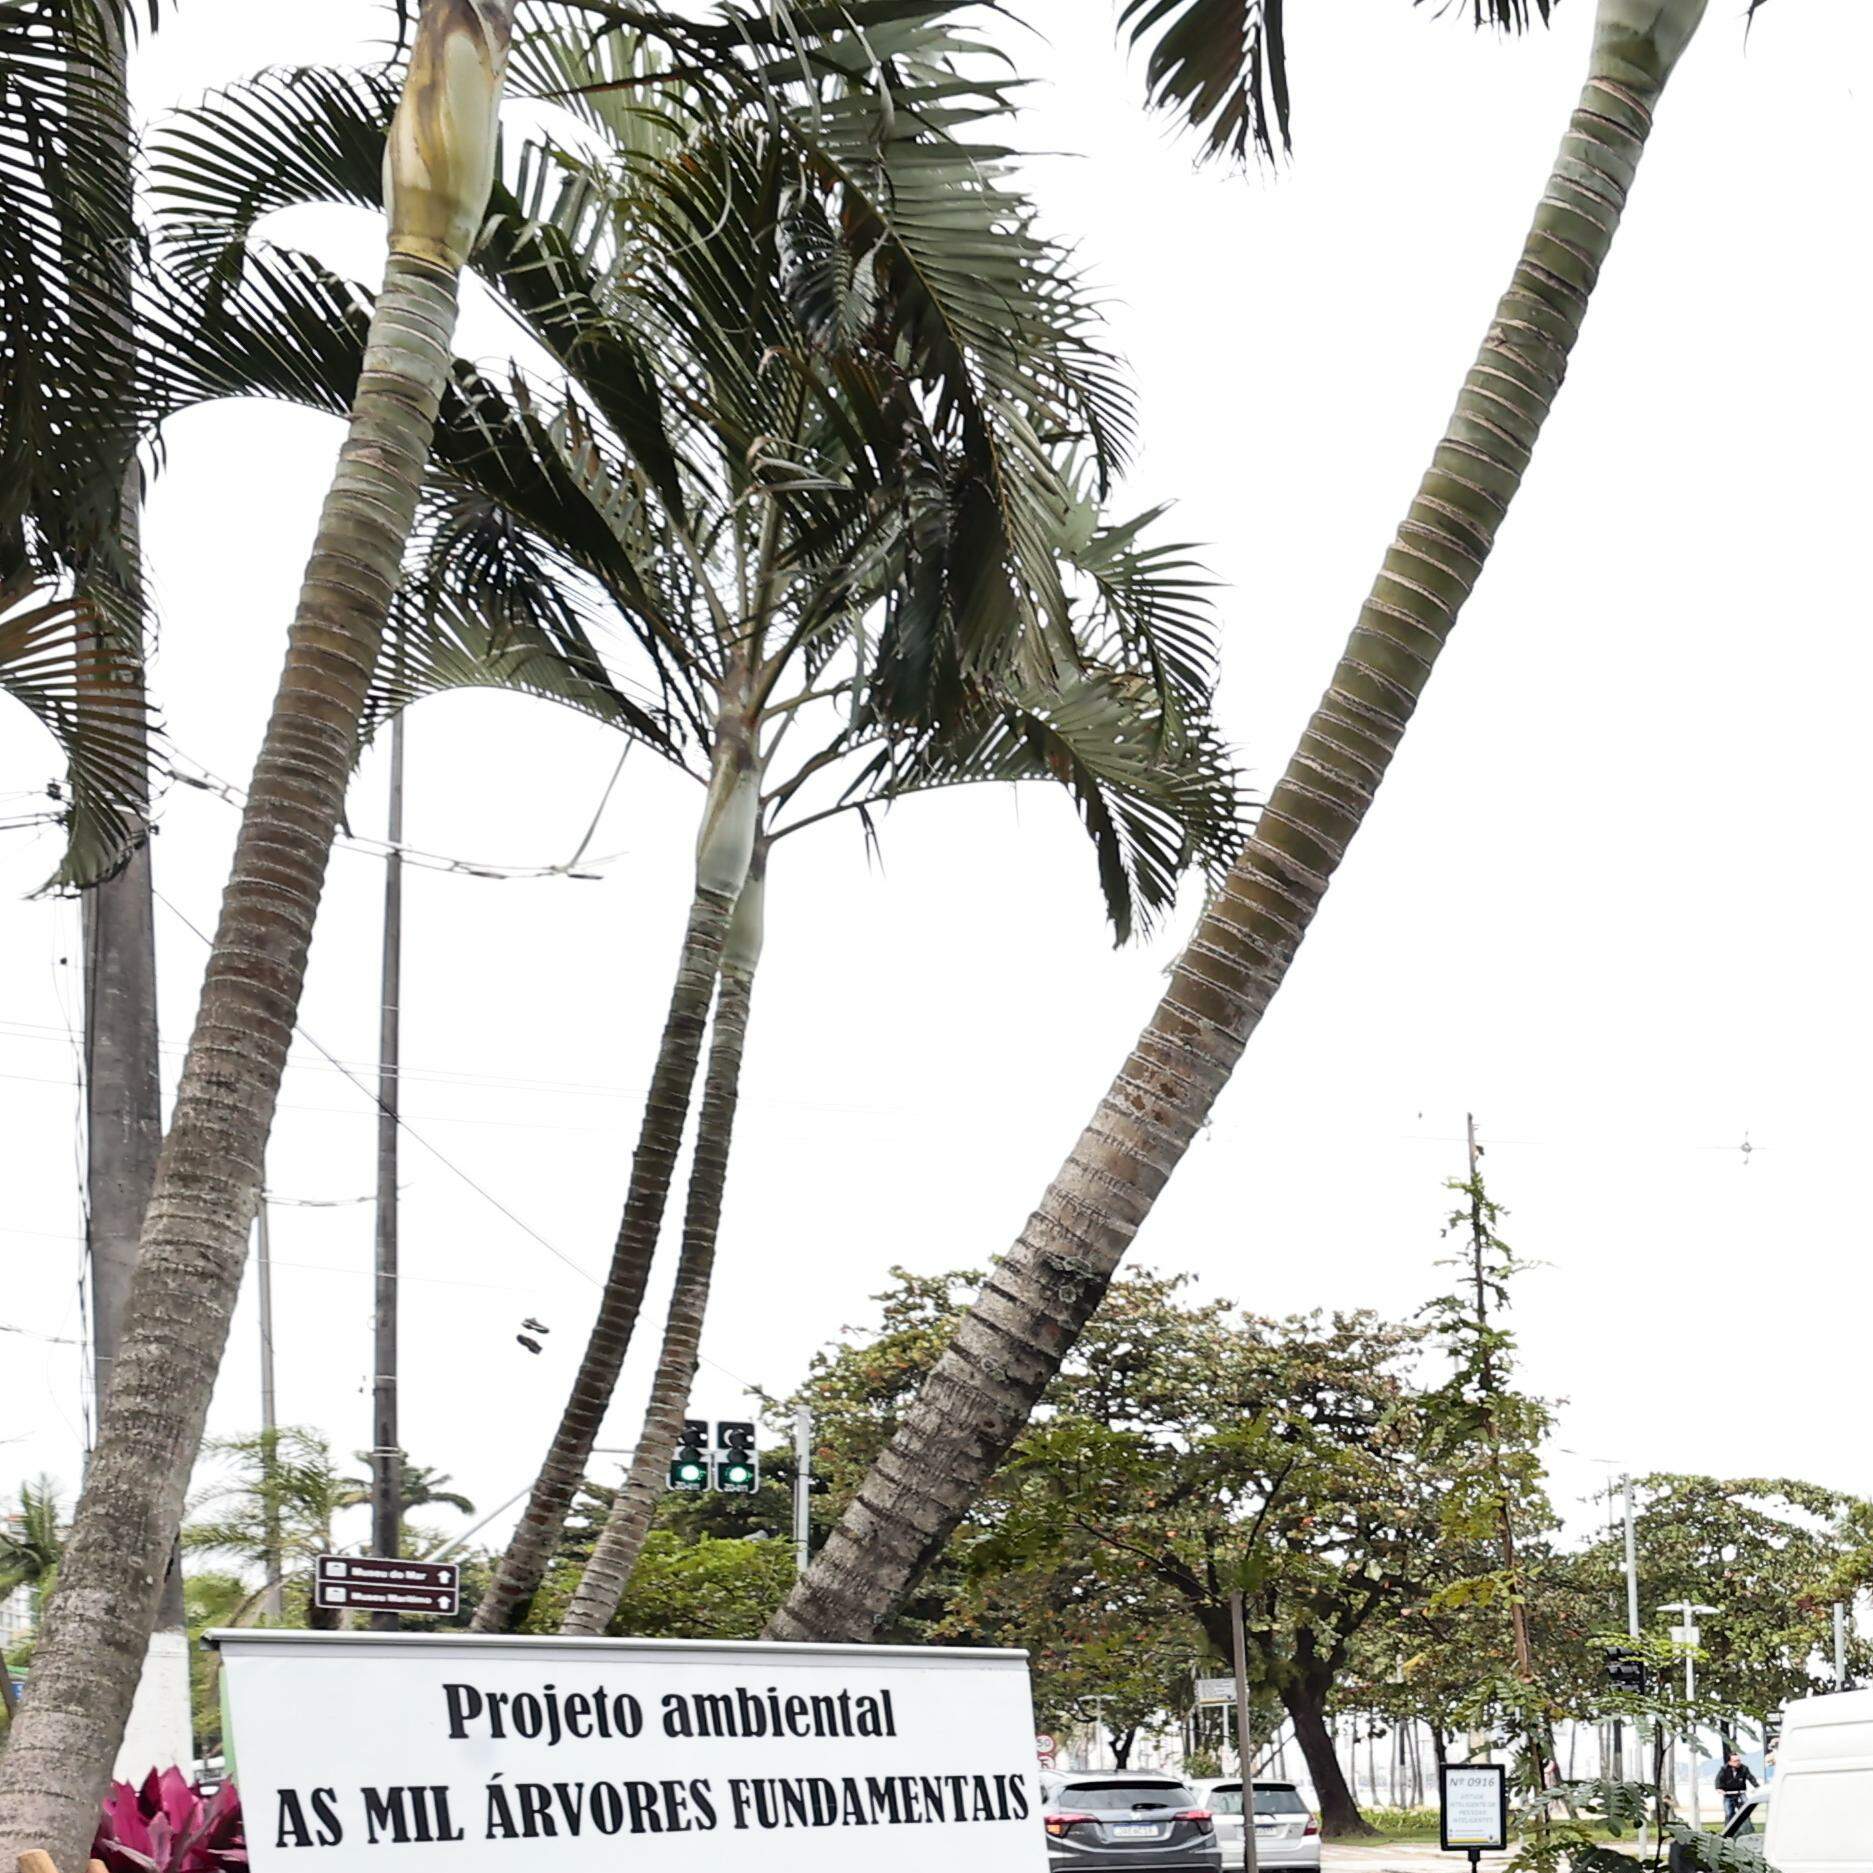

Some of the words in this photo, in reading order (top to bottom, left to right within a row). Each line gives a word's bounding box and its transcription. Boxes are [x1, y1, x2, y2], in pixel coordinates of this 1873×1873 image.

[351, 1567, 388, 1578] Museu
[443, 1684, 642, 1746] Projeto
[662, 1687, 896, 1737] ambiental
[1467, 1777, 1495, 1787] 0916
[276, 1788, 342, 1847] AS
[362, 1786, 463, 1844] MIL
[486, 1773, 716, 1839] ÁRVORES
[732, 1774, 1028, 1829] FUNDAMENTAIS
